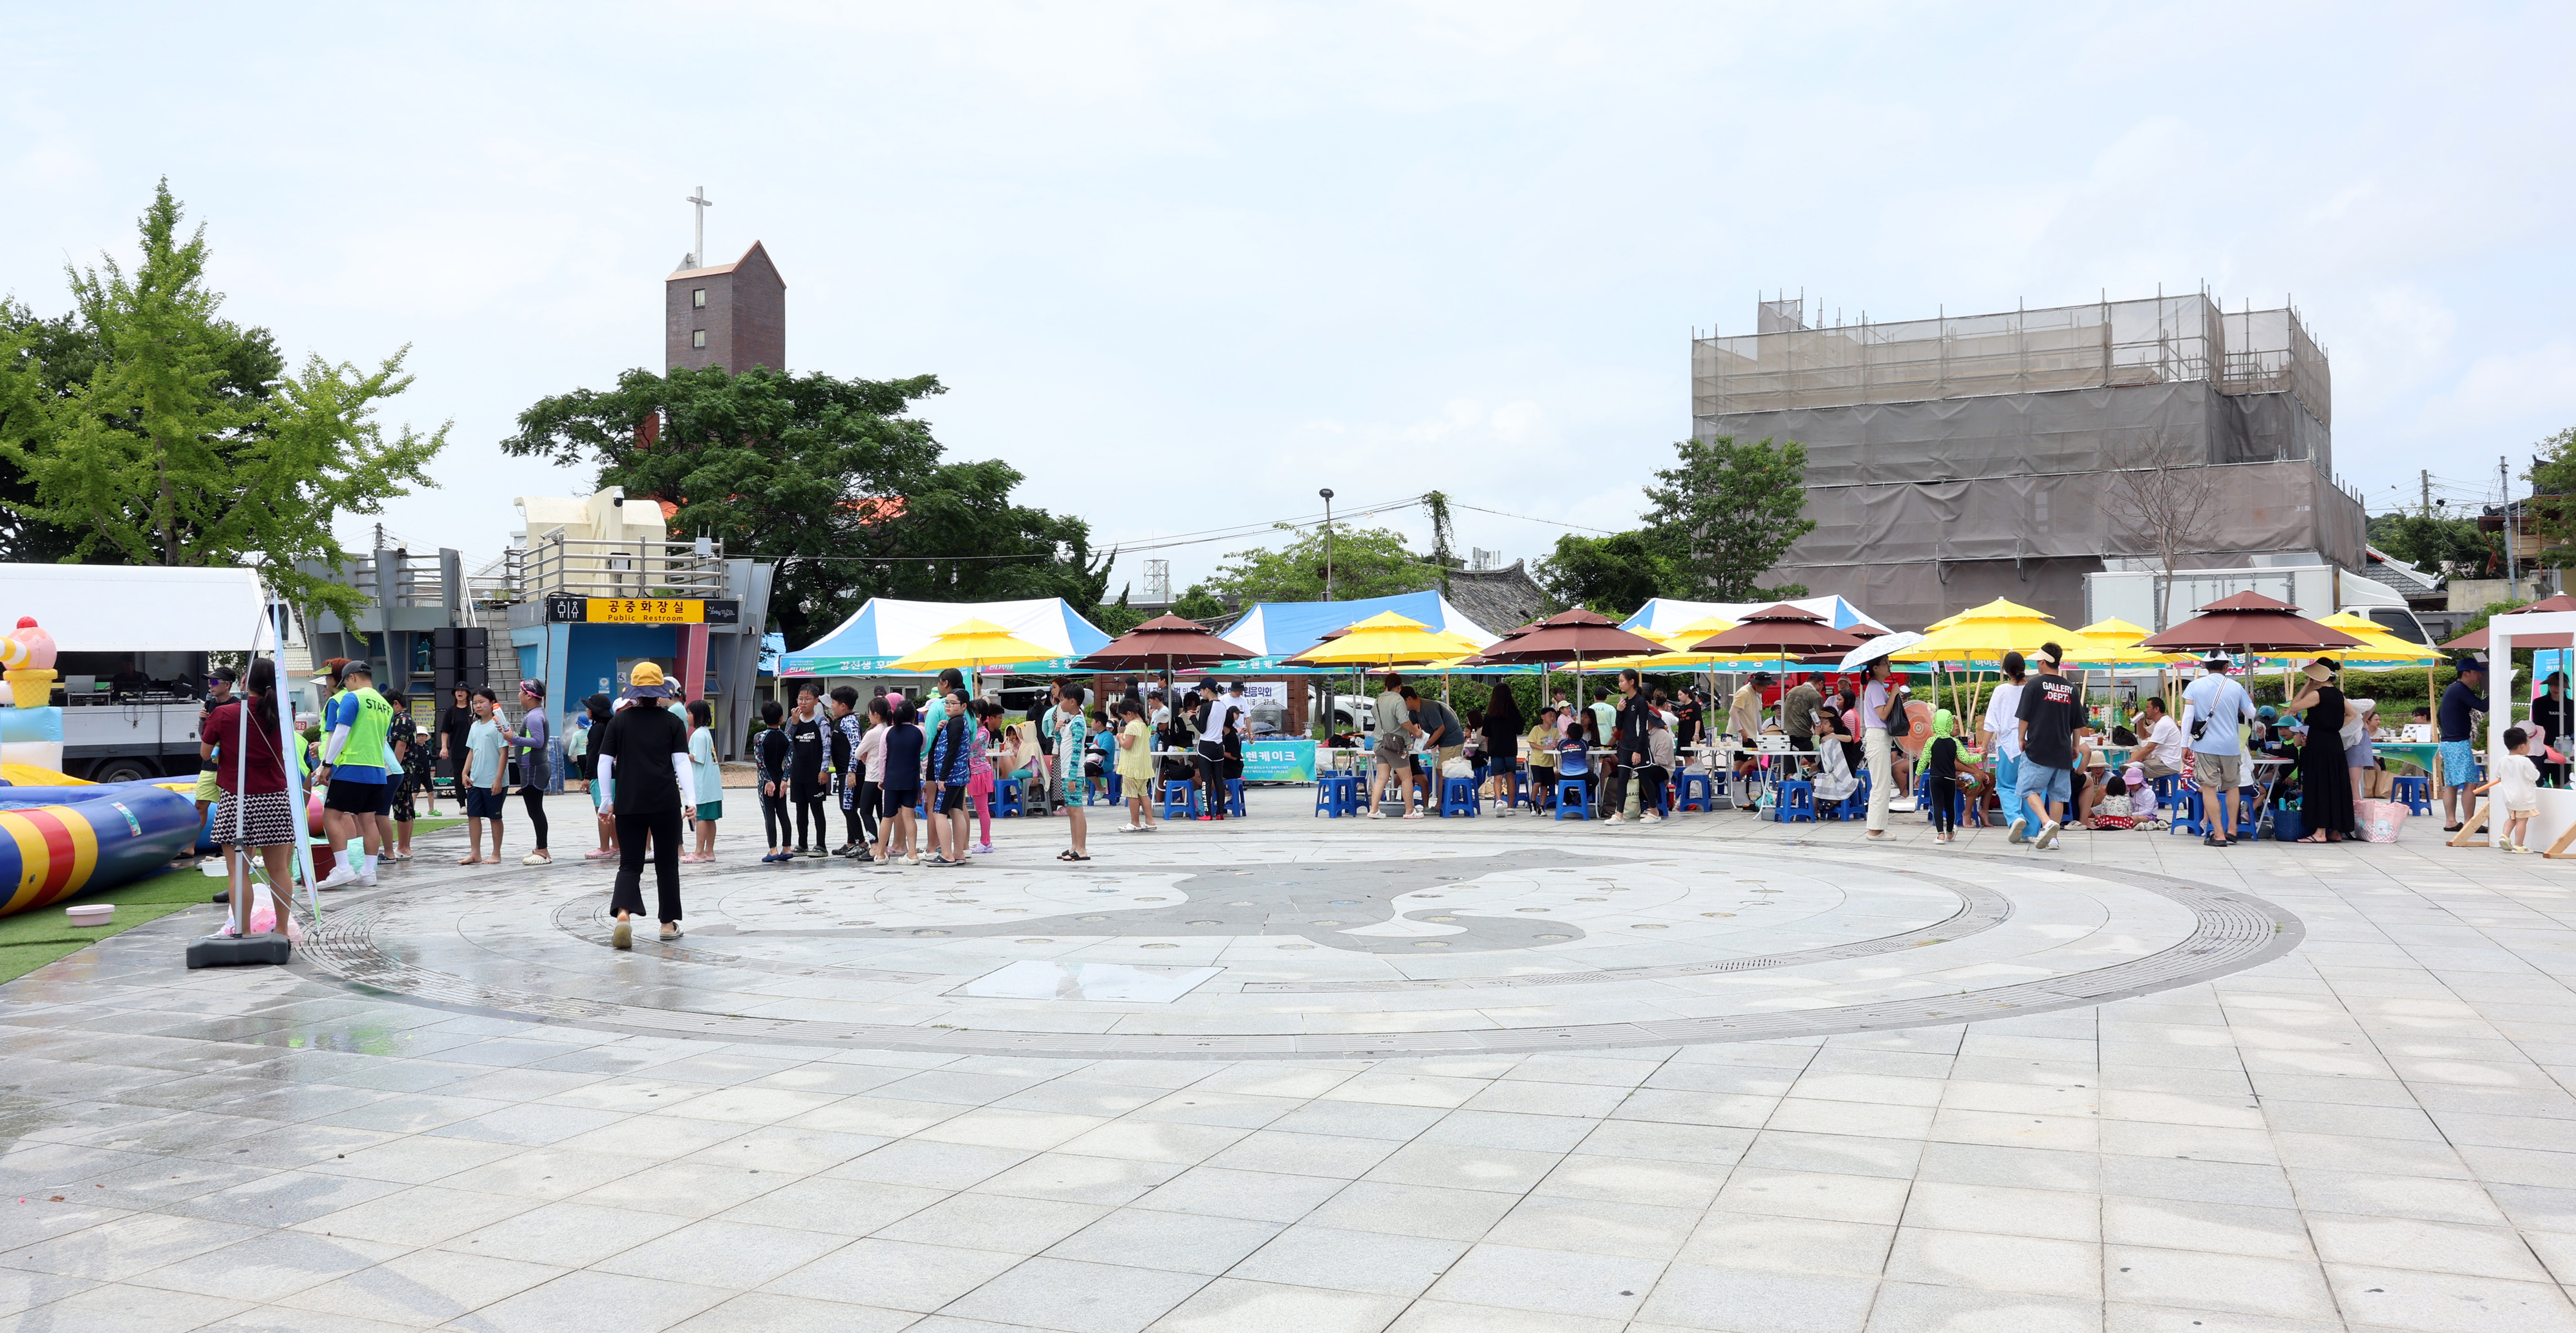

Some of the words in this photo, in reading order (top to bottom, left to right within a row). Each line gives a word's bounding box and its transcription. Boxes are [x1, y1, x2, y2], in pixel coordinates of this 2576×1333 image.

[608, 601, 684, 613] 공중화장실
[840, 660, 872, 670] 강선생
[1242, 687, 1272, 697] 린음악회
[2042, 681, 2074, 695] GALLERY
[2047, 691, 2069, 703] DEPT.
[366, 698, 391, 716] STAFF
